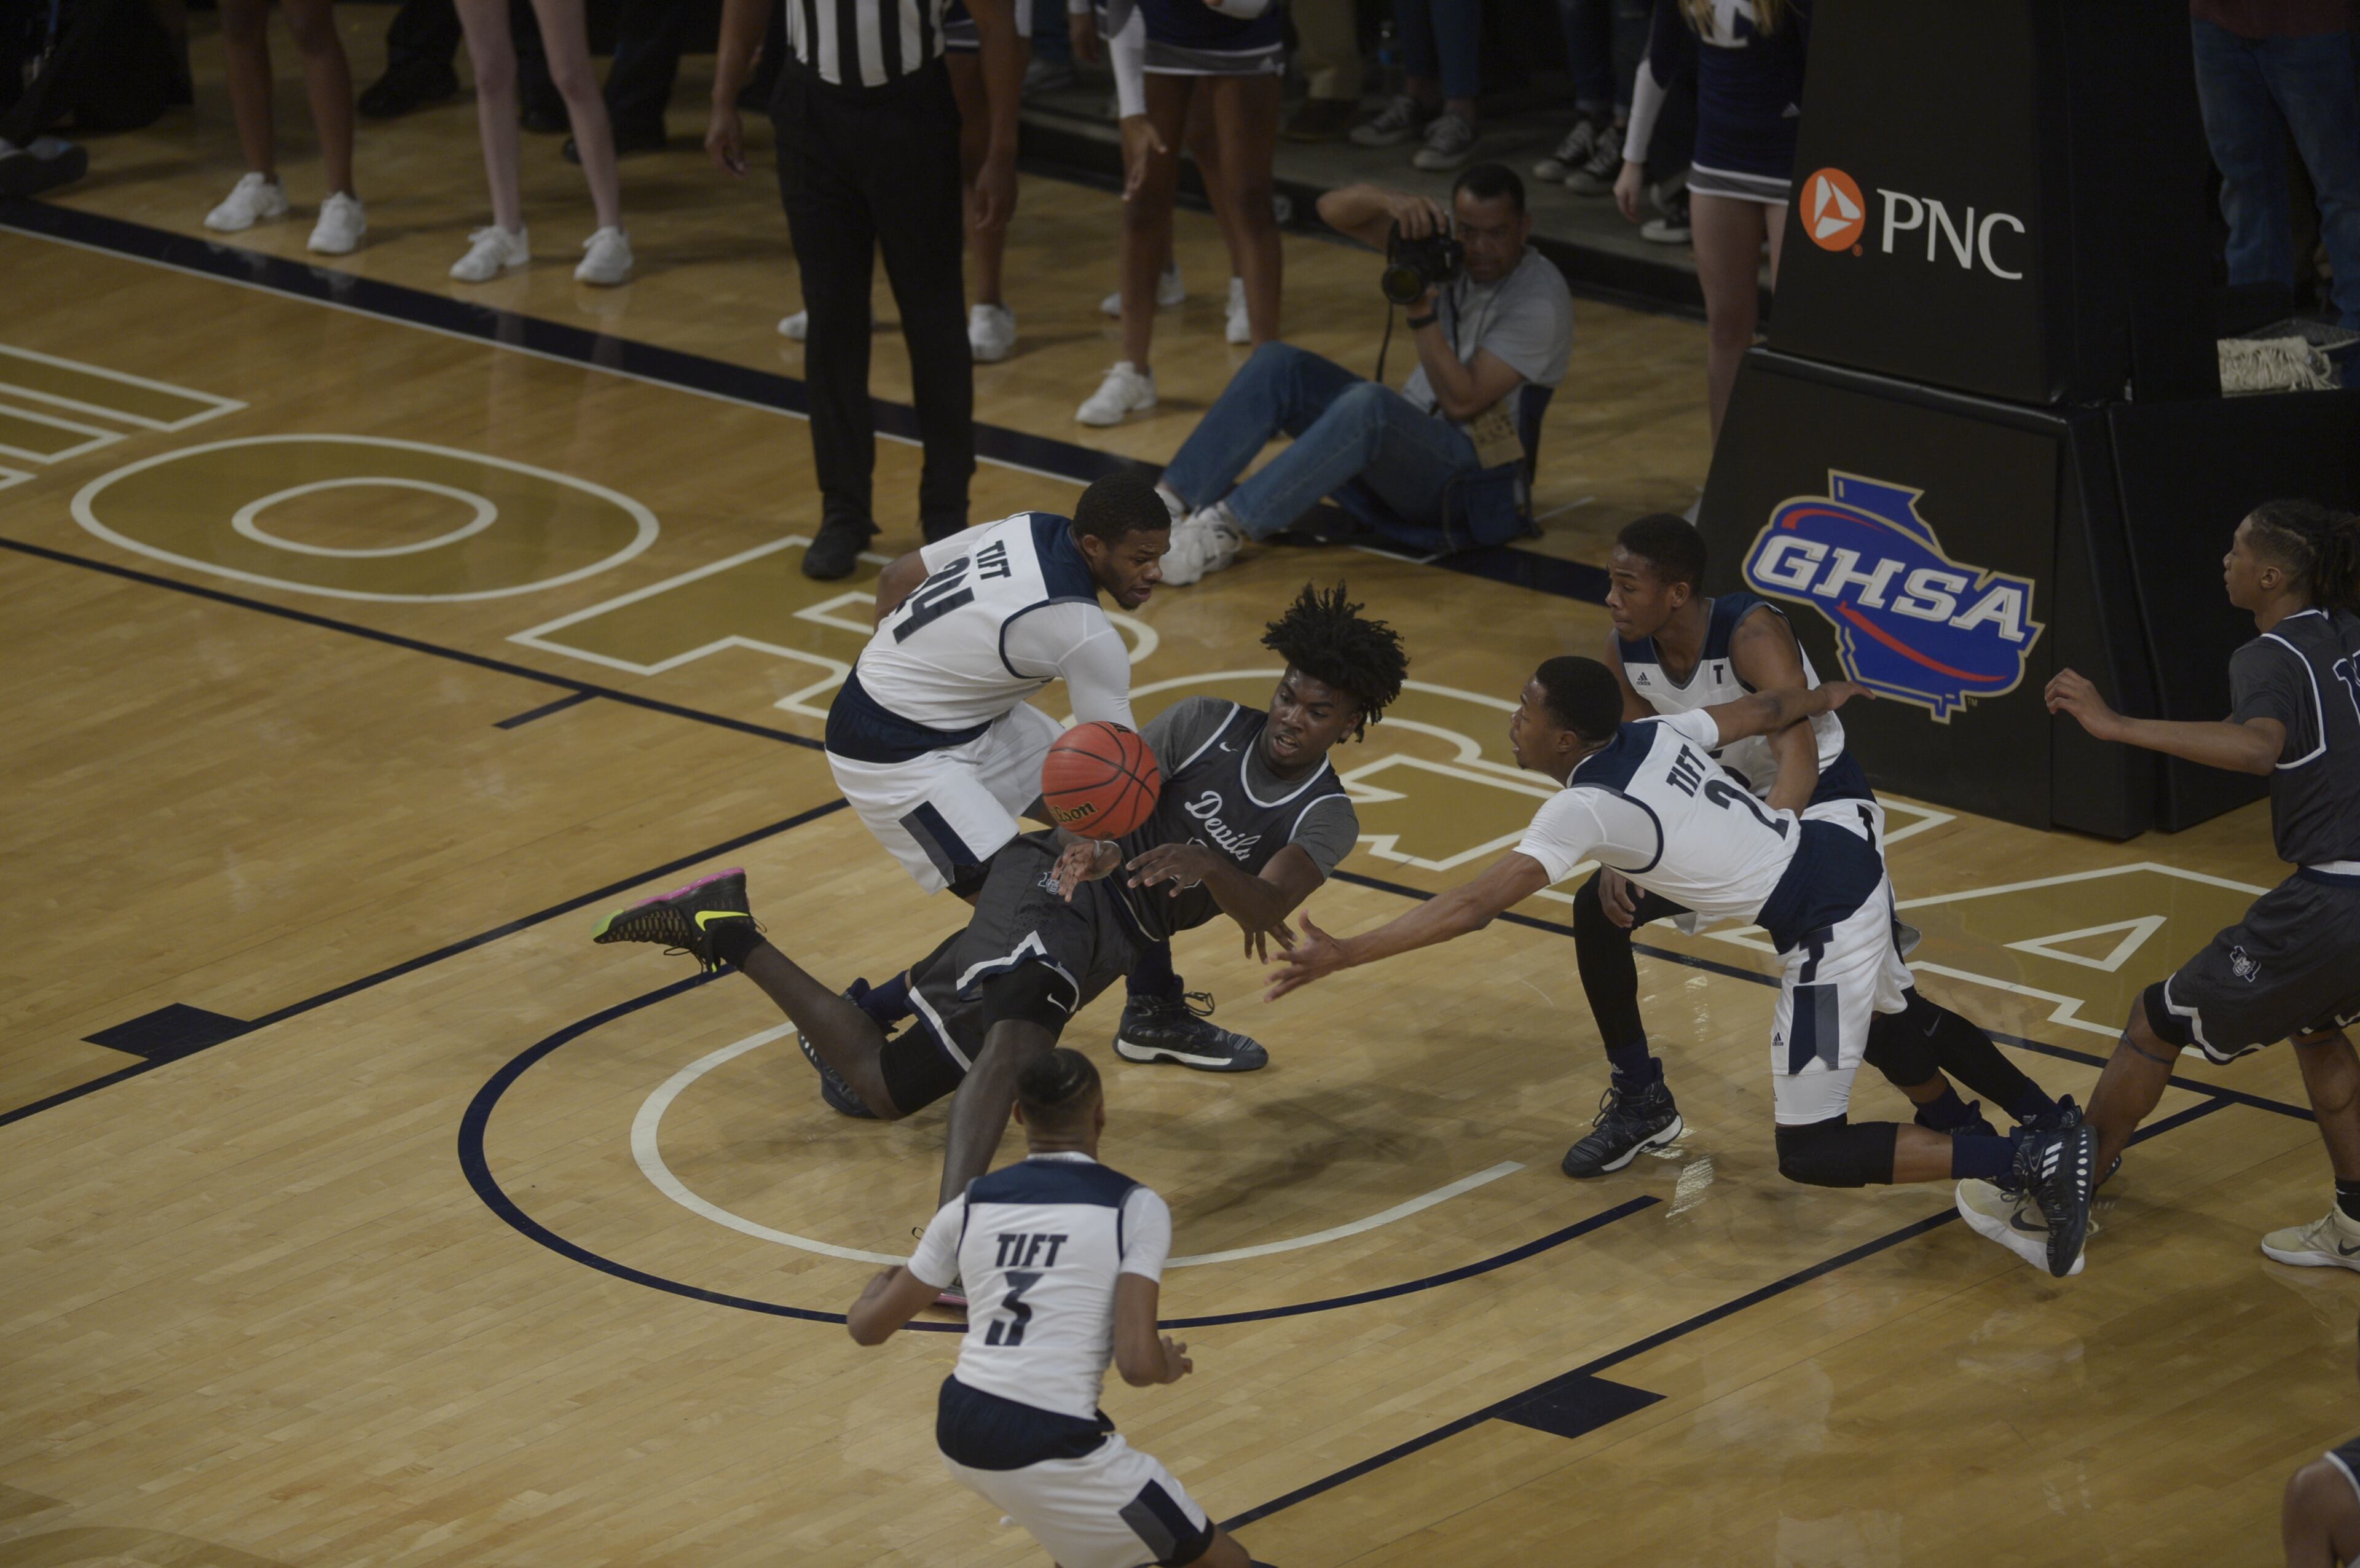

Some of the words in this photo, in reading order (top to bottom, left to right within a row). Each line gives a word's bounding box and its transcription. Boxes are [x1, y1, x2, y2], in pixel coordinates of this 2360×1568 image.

[1876, 187, 2026, 280] PNC
[976, 539, 1012, 581] TIFT
[1752, 534, 2026, 643] GHSA
[1713, 664, 1724, 685] T
[1665, 743, 1706, 798] TIFT
[1184, 790, 1262, 861] Devils
[1704, 779, 1790, 842] 2
[995, 1233, 1070, 1268] TIFT
[984, 1271, 1045, 1346] 3
